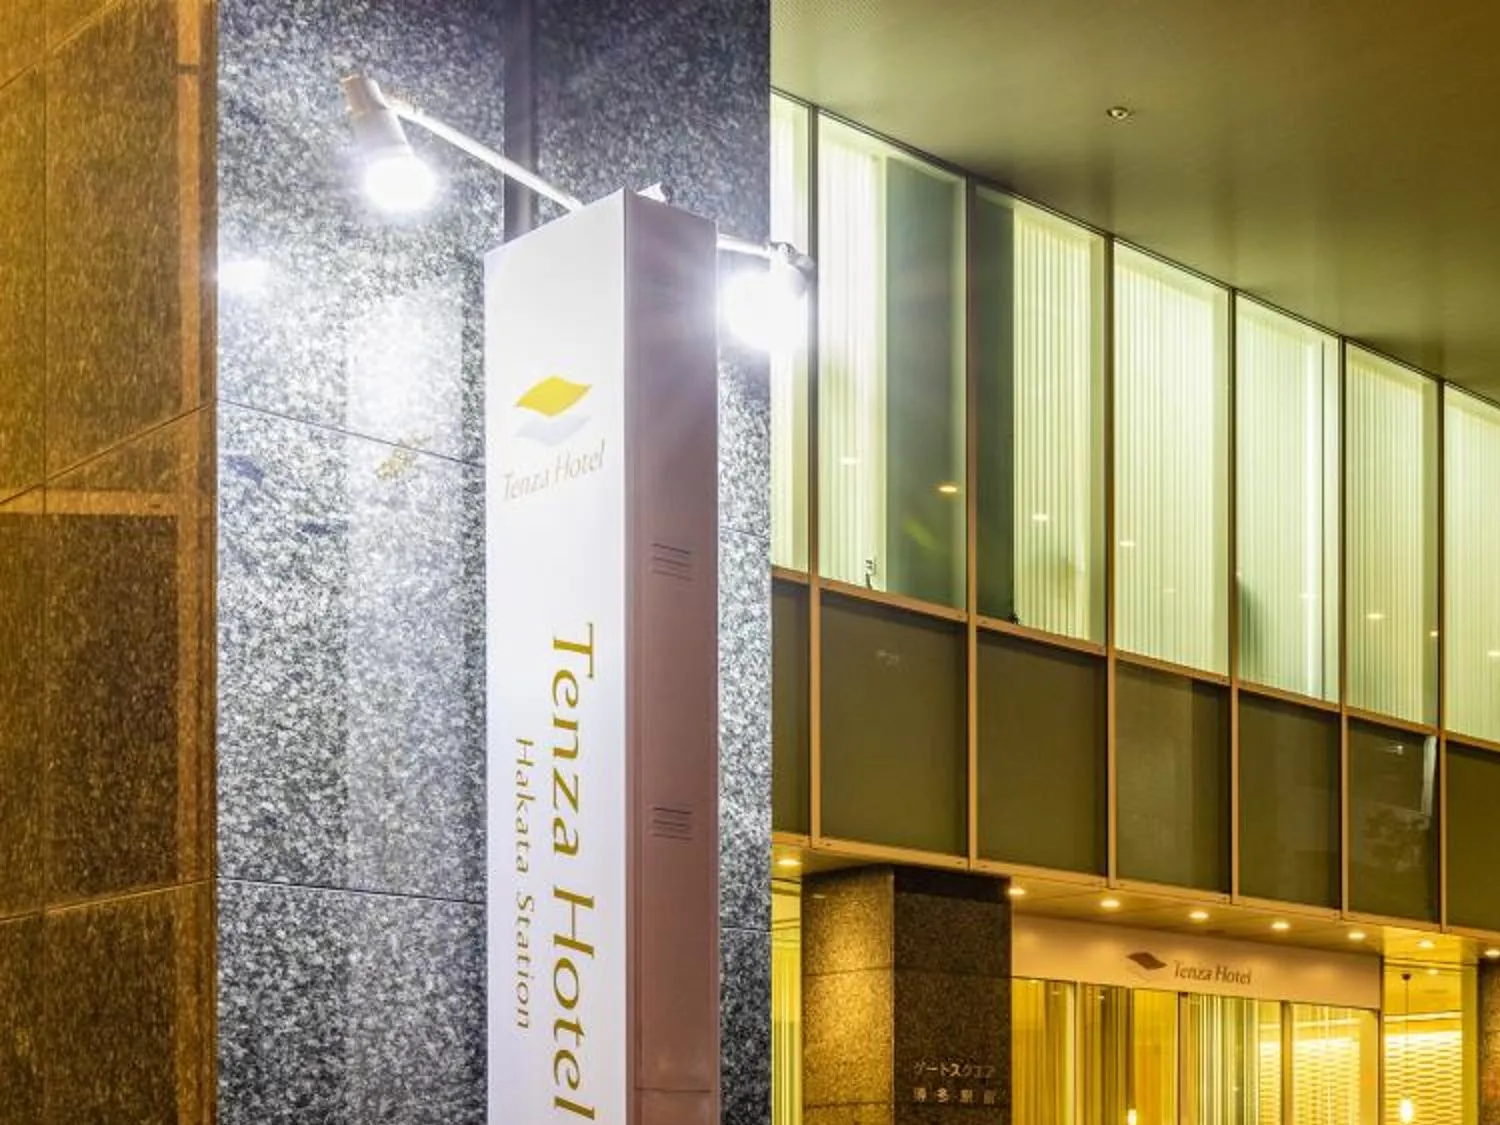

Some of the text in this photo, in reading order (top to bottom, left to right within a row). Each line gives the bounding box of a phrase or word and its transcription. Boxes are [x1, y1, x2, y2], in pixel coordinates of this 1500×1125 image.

[504, 438, 605, 501] Tenza Hotel
[515, 738, 535, 1029] Hakata Station
[552, 622, 595, 1121] Tenza Hotel
[1174, 960, 1251, 985] Tenza Hotel
